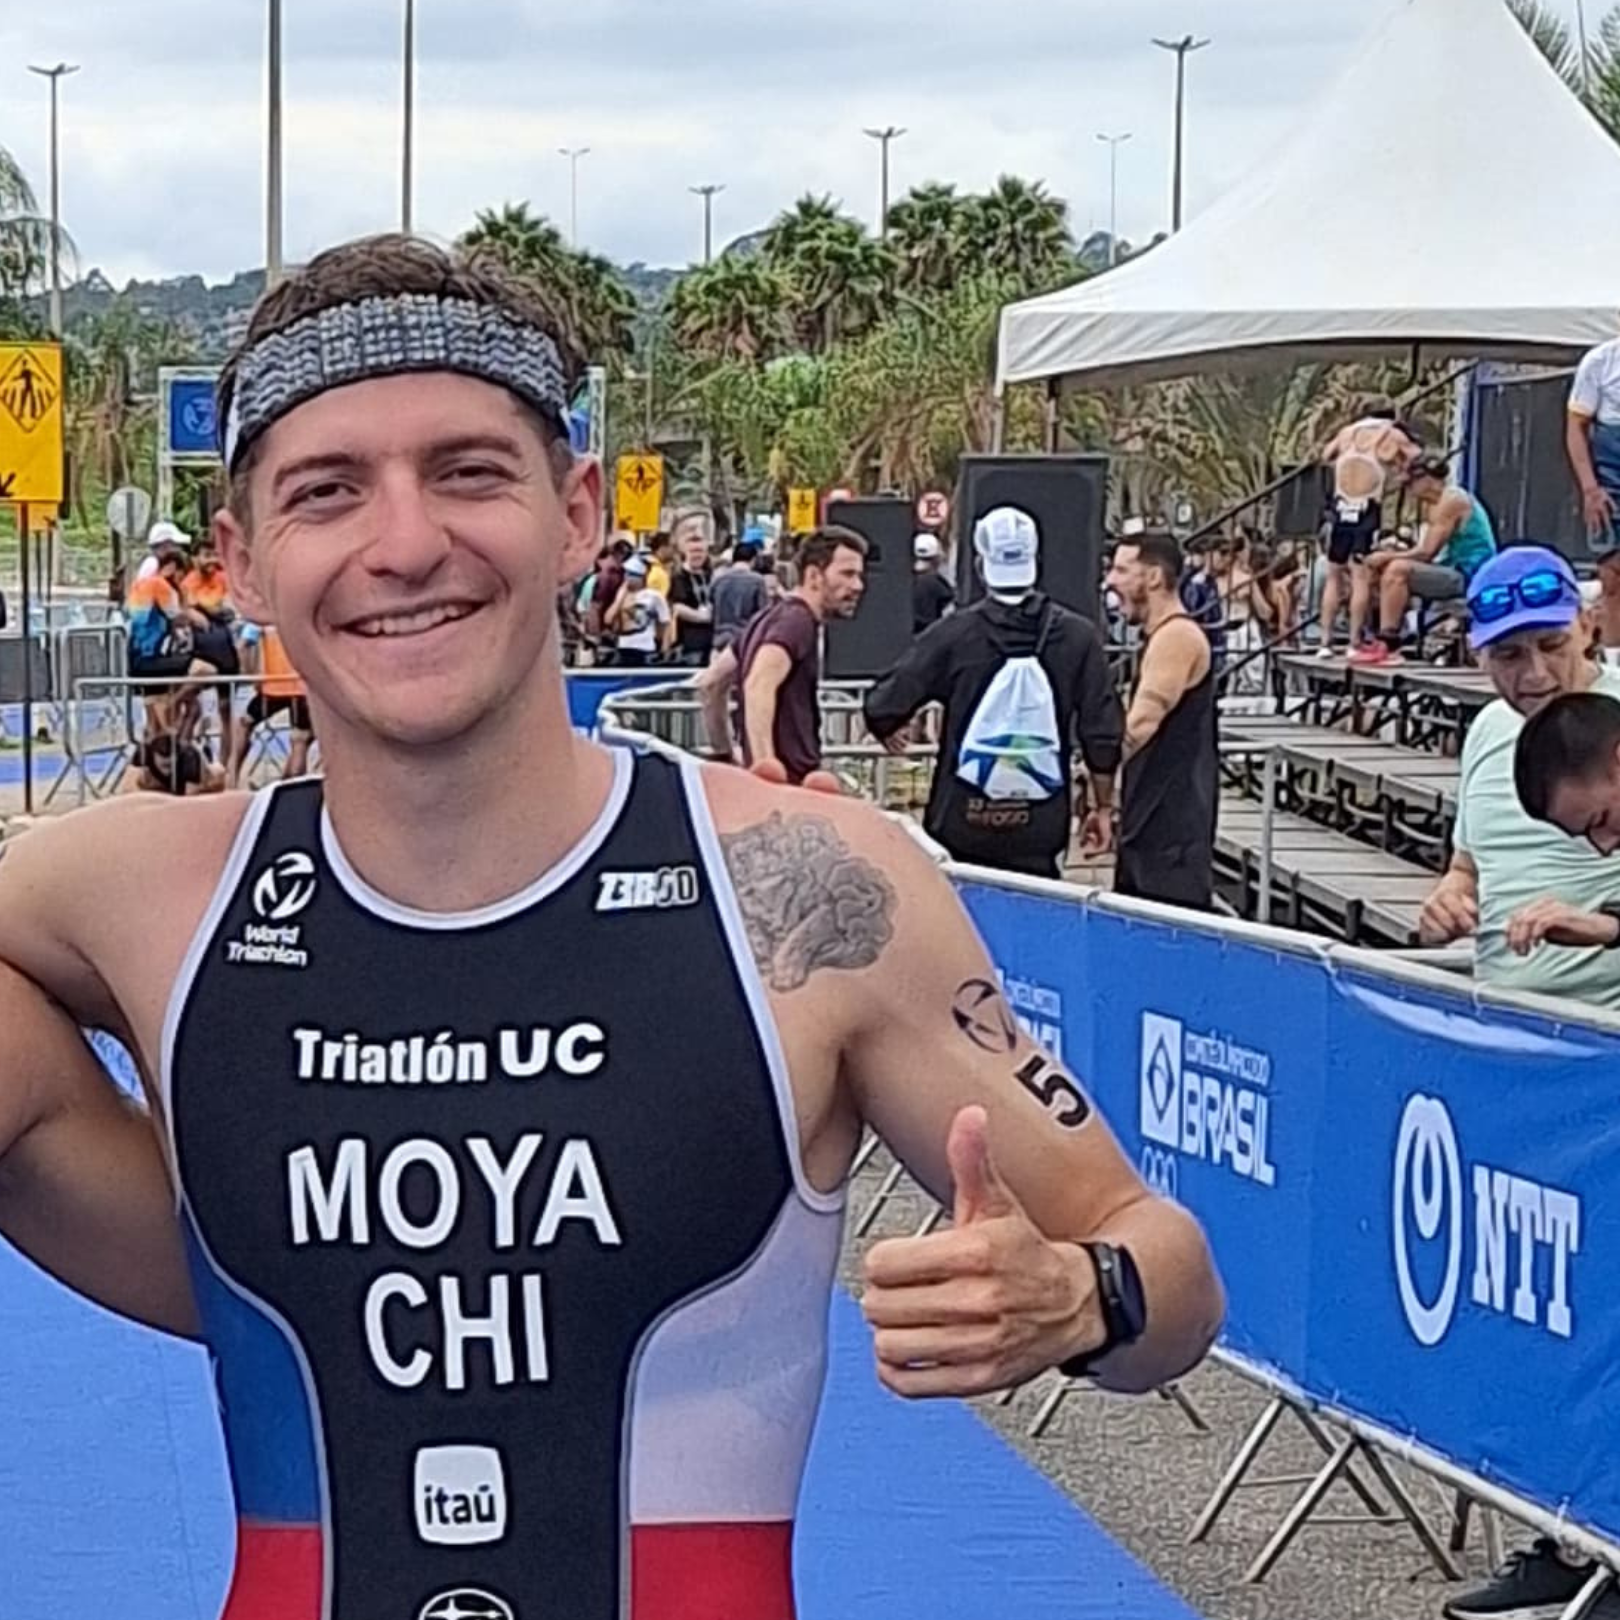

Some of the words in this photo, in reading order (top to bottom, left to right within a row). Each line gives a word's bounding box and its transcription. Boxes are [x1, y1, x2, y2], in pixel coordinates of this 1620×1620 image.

[245, 923, 300, 945] World
[293, 1029, 486, 1083] Triatlón
[499, 1024, 604, 1076] UC
[1014, 1054, 1091, 1128] 5
[1181, 1069, 1275, 1186] BRASIL
[287, 1134, 621, 1248] MOYA
[1472, 1165, 1579, 1339] NTT
[364, 1272, 549, 1390] CHI
[423, 1485, 497, 1526] itaú
